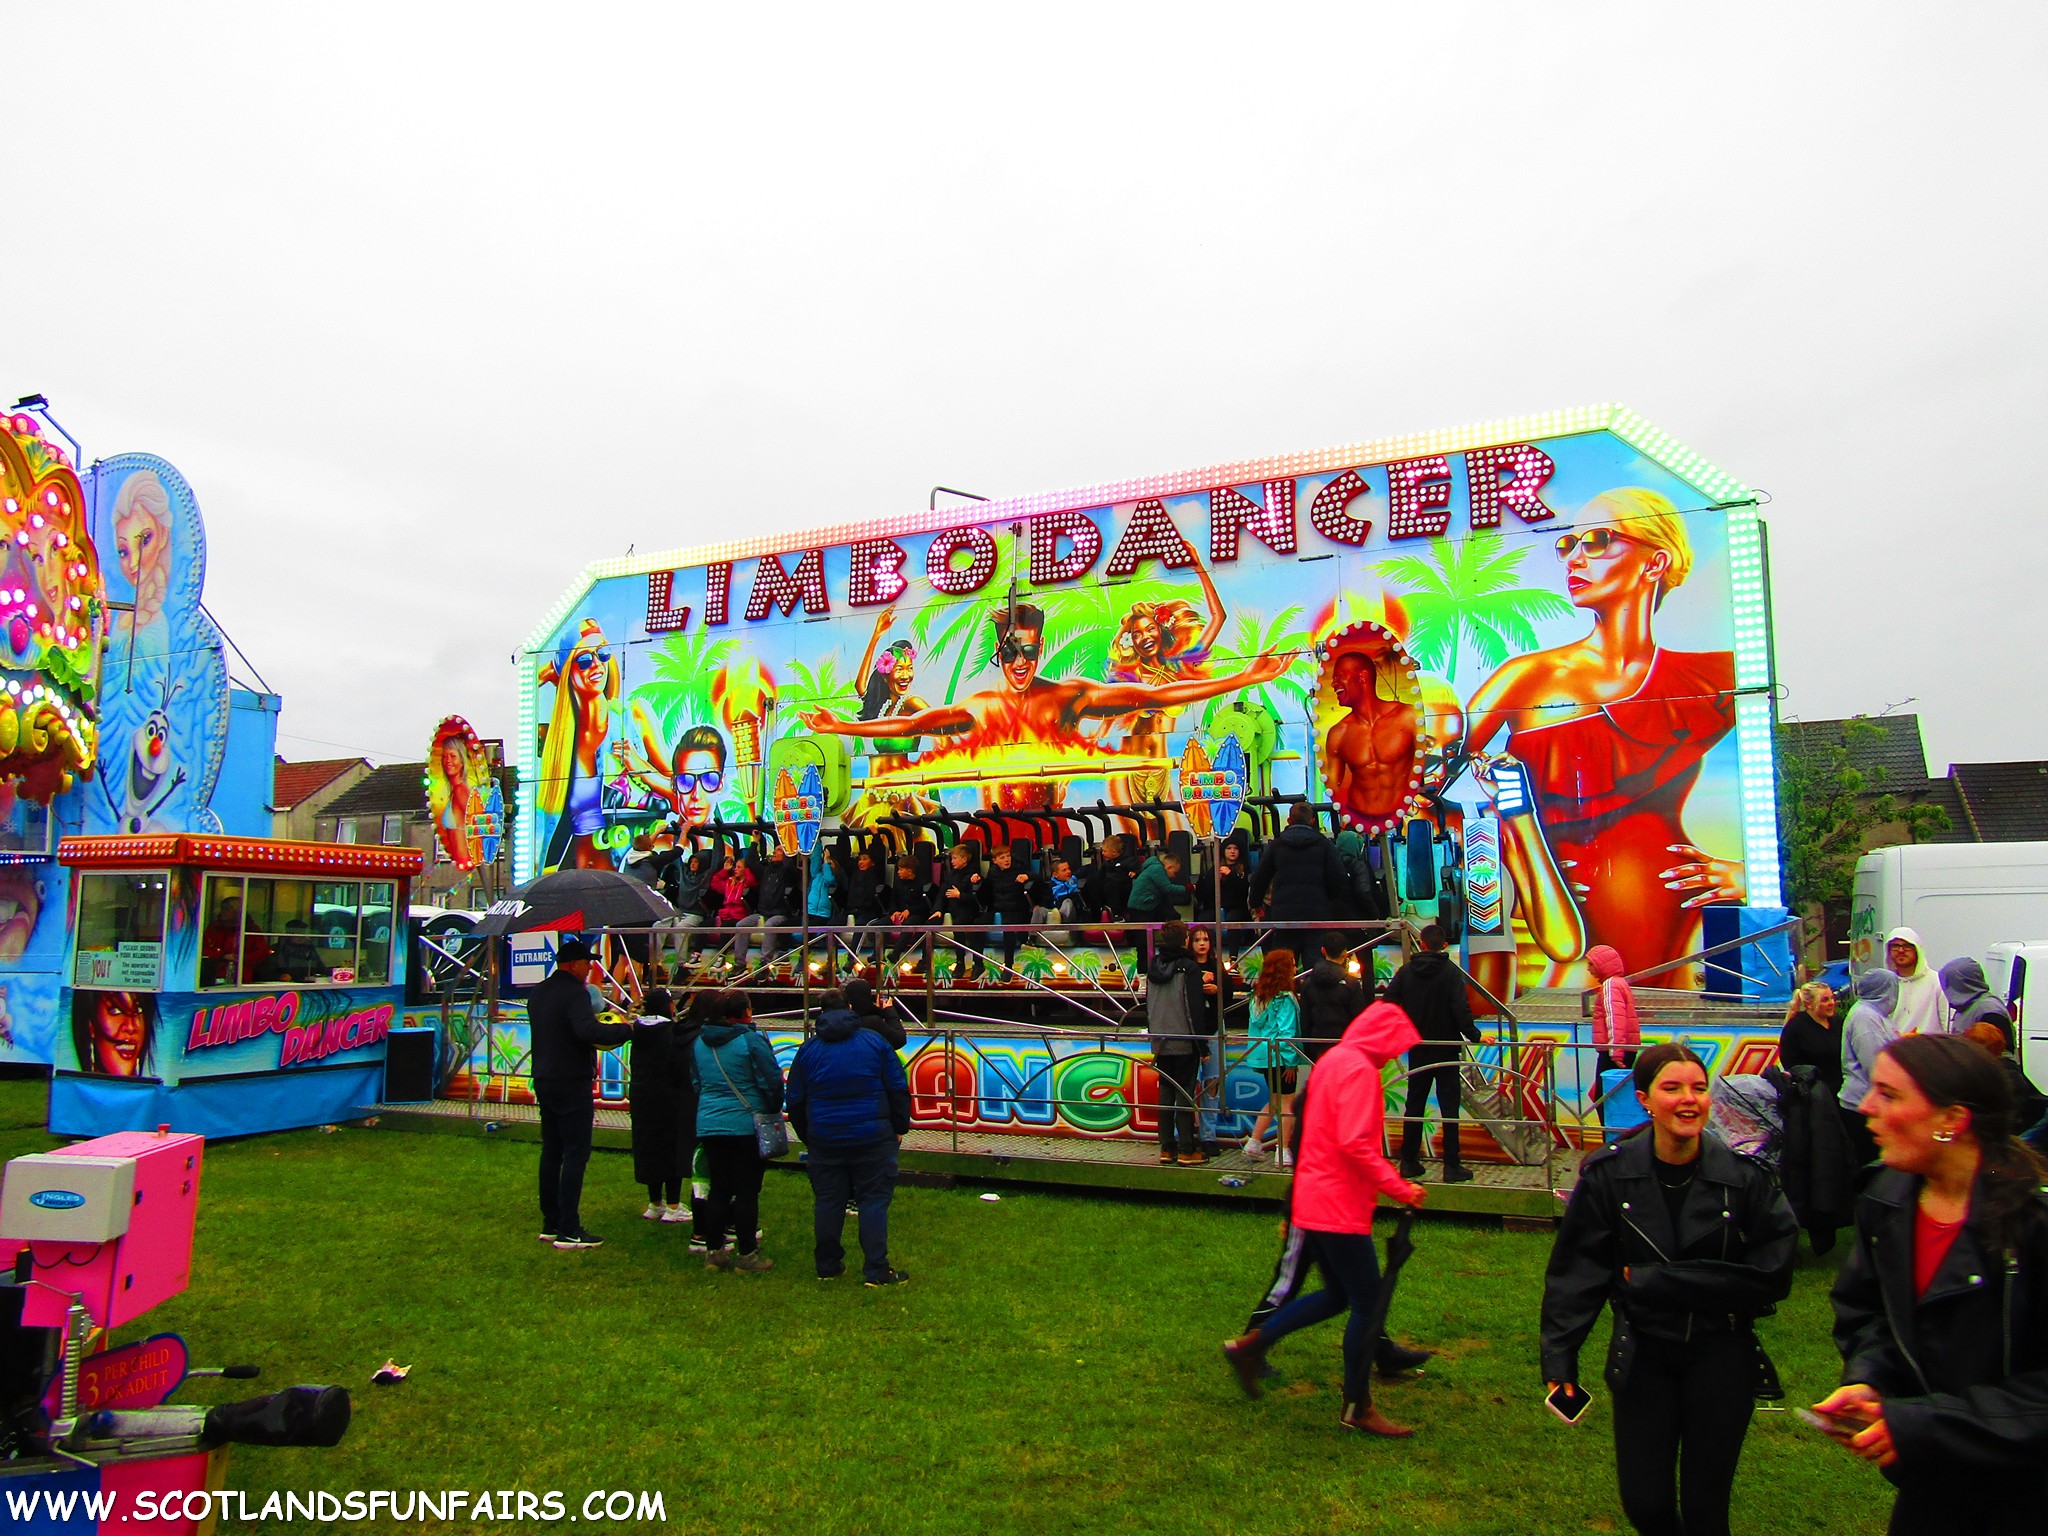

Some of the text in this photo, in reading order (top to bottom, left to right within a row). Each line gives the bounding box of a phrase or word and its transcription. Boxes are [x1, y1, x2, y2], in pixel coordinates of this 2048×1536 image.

[645, 444, 1556, 633] LIMBO DANCER
[1189, 771, 1236, 786] LIMBO
[1182, 785, 1242, 799] DANCER
[781, 796, 816, 811] LIMBO
[776, 808, 820, 823] DANCER
[514, 951, 553, 964] ENTRANCE
[188, 991, 300, 1050] LIMBO
[280, 1004, 394, 1067] DANCER
[104, 1360, 128, 1382] PER
[129, 1347, 170, 1374] CHILD
[126, 1369, 169, 1398] ADULT
